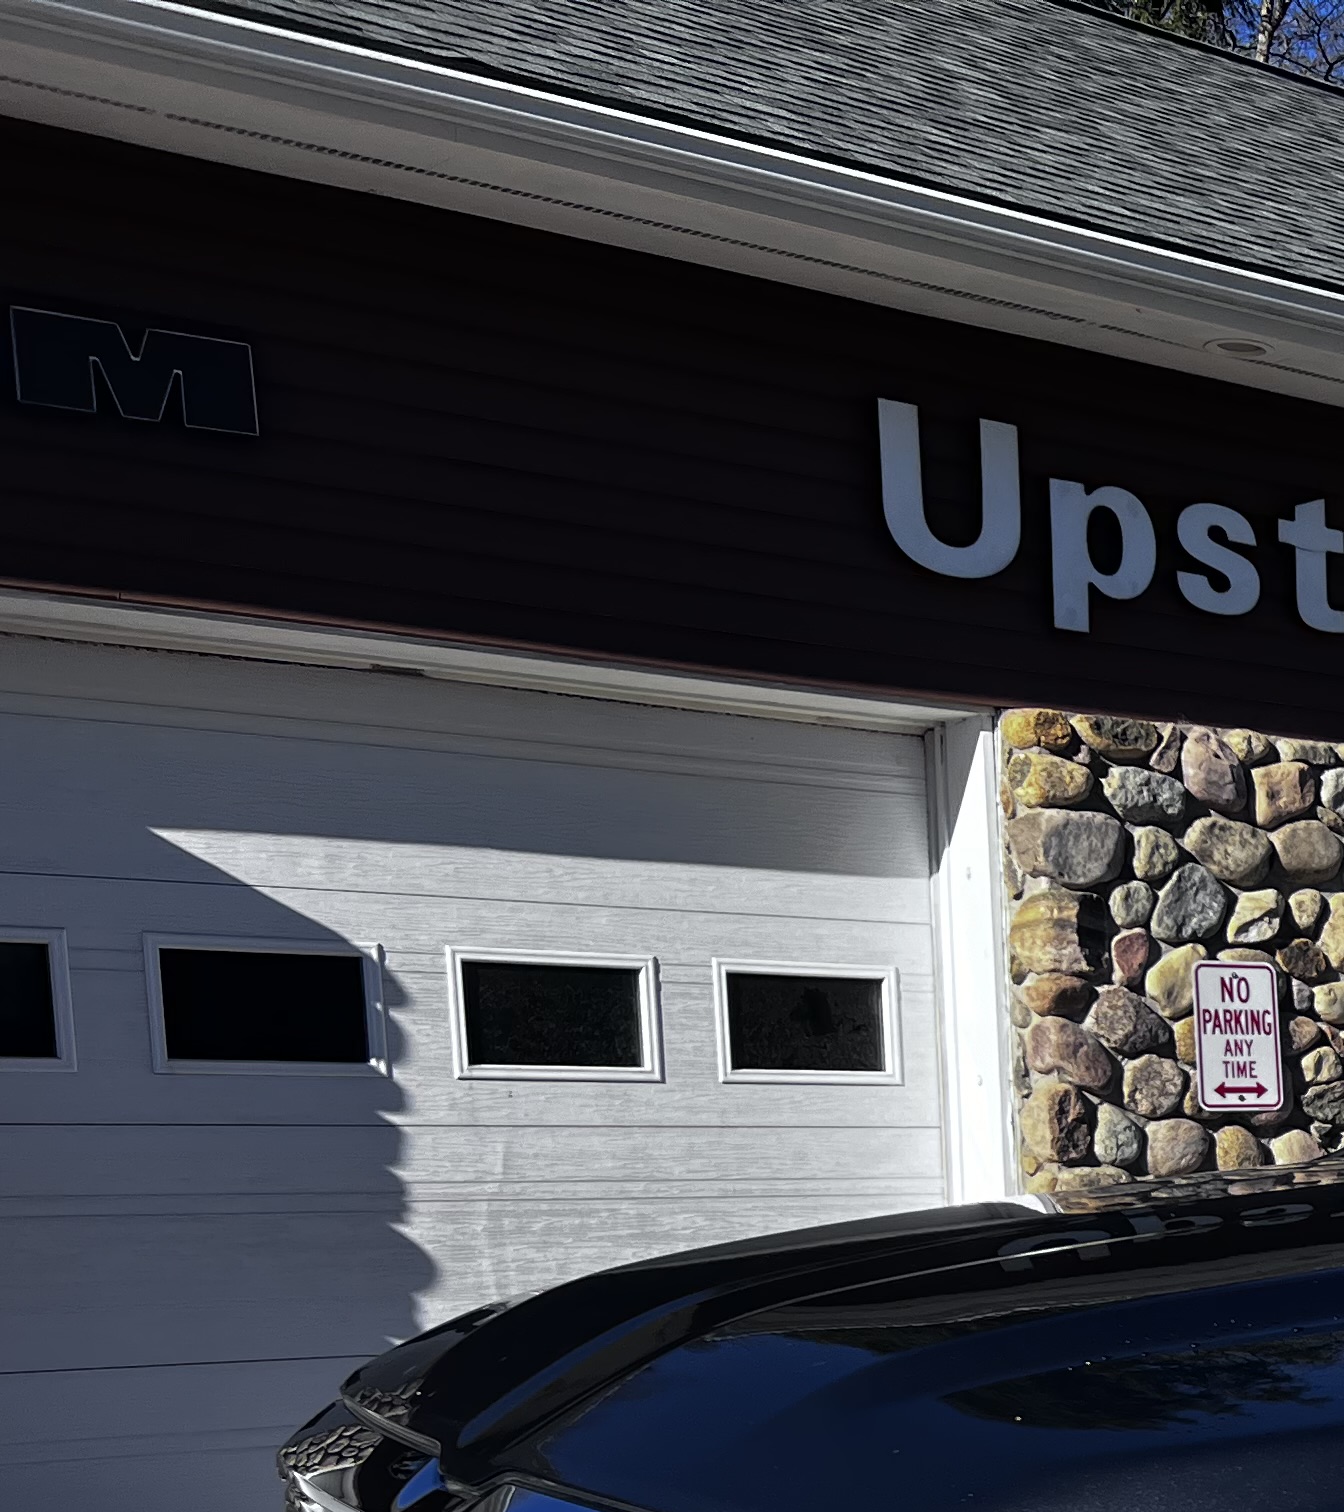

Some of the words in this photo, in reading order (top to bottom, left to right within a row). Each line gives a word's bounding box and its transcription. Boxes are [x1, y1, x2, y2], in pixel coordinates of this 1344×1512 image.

[1219, 976, 1250, 1004] NO
[1202, 1008, 1272, 1036] PARKING
[1223, 1039, 1254, 1057] ANY
[1222, 1060, 1258, 1079] TIME
